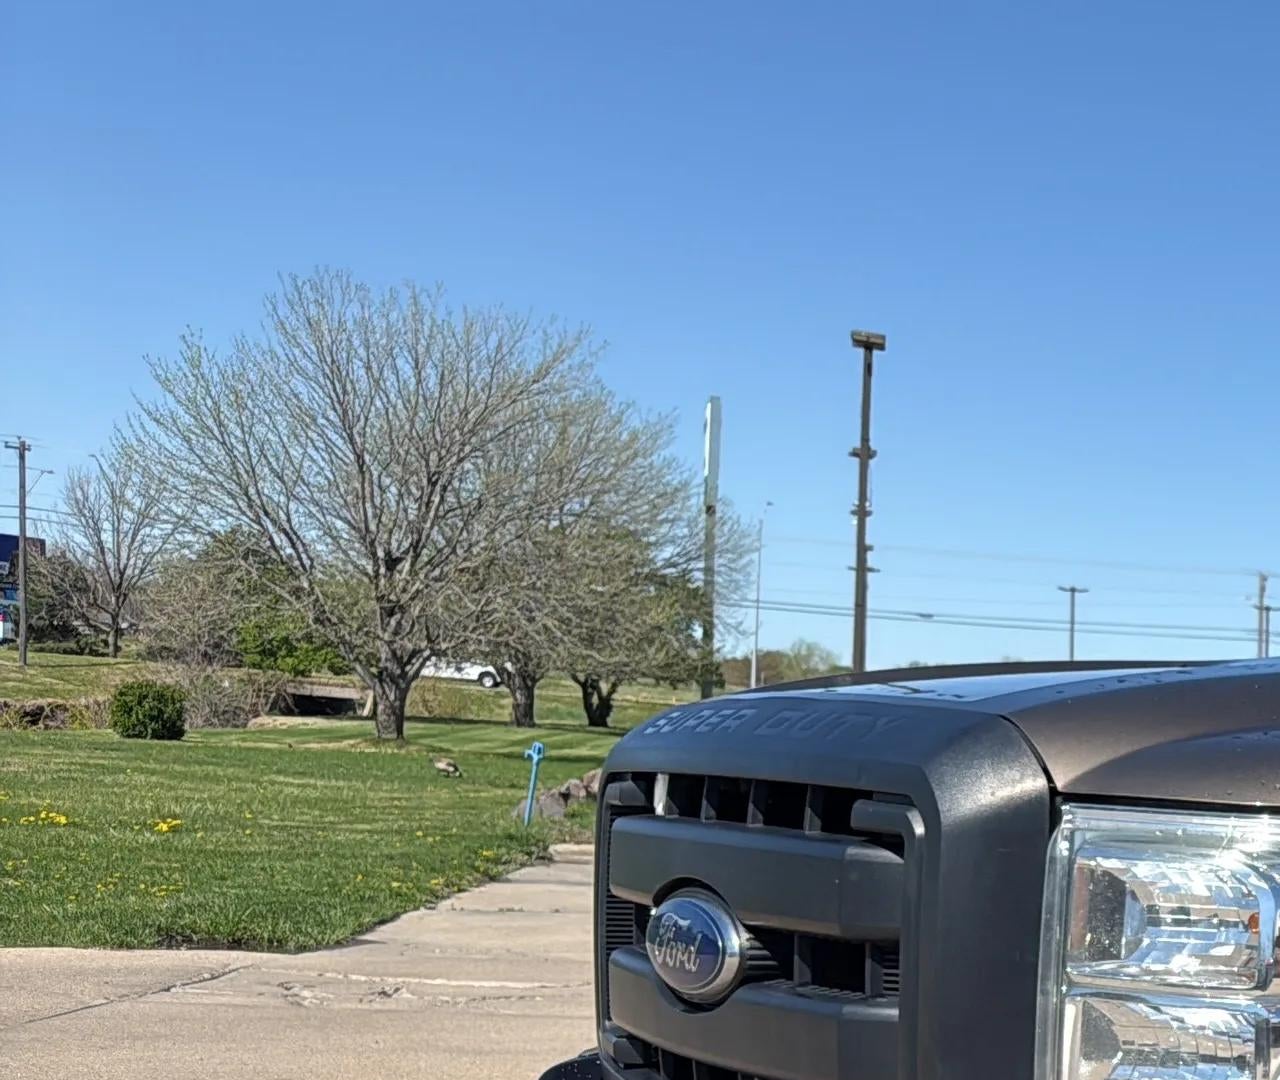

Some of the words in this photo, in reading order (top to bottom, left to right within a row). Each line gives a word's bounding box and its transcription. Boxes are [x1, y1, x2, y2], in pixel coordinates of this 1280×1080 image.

[643, 708, 757, 735] SUPER
[753, 709, 906, 742] DUTY
[655, 912, 703, 973] Ford
